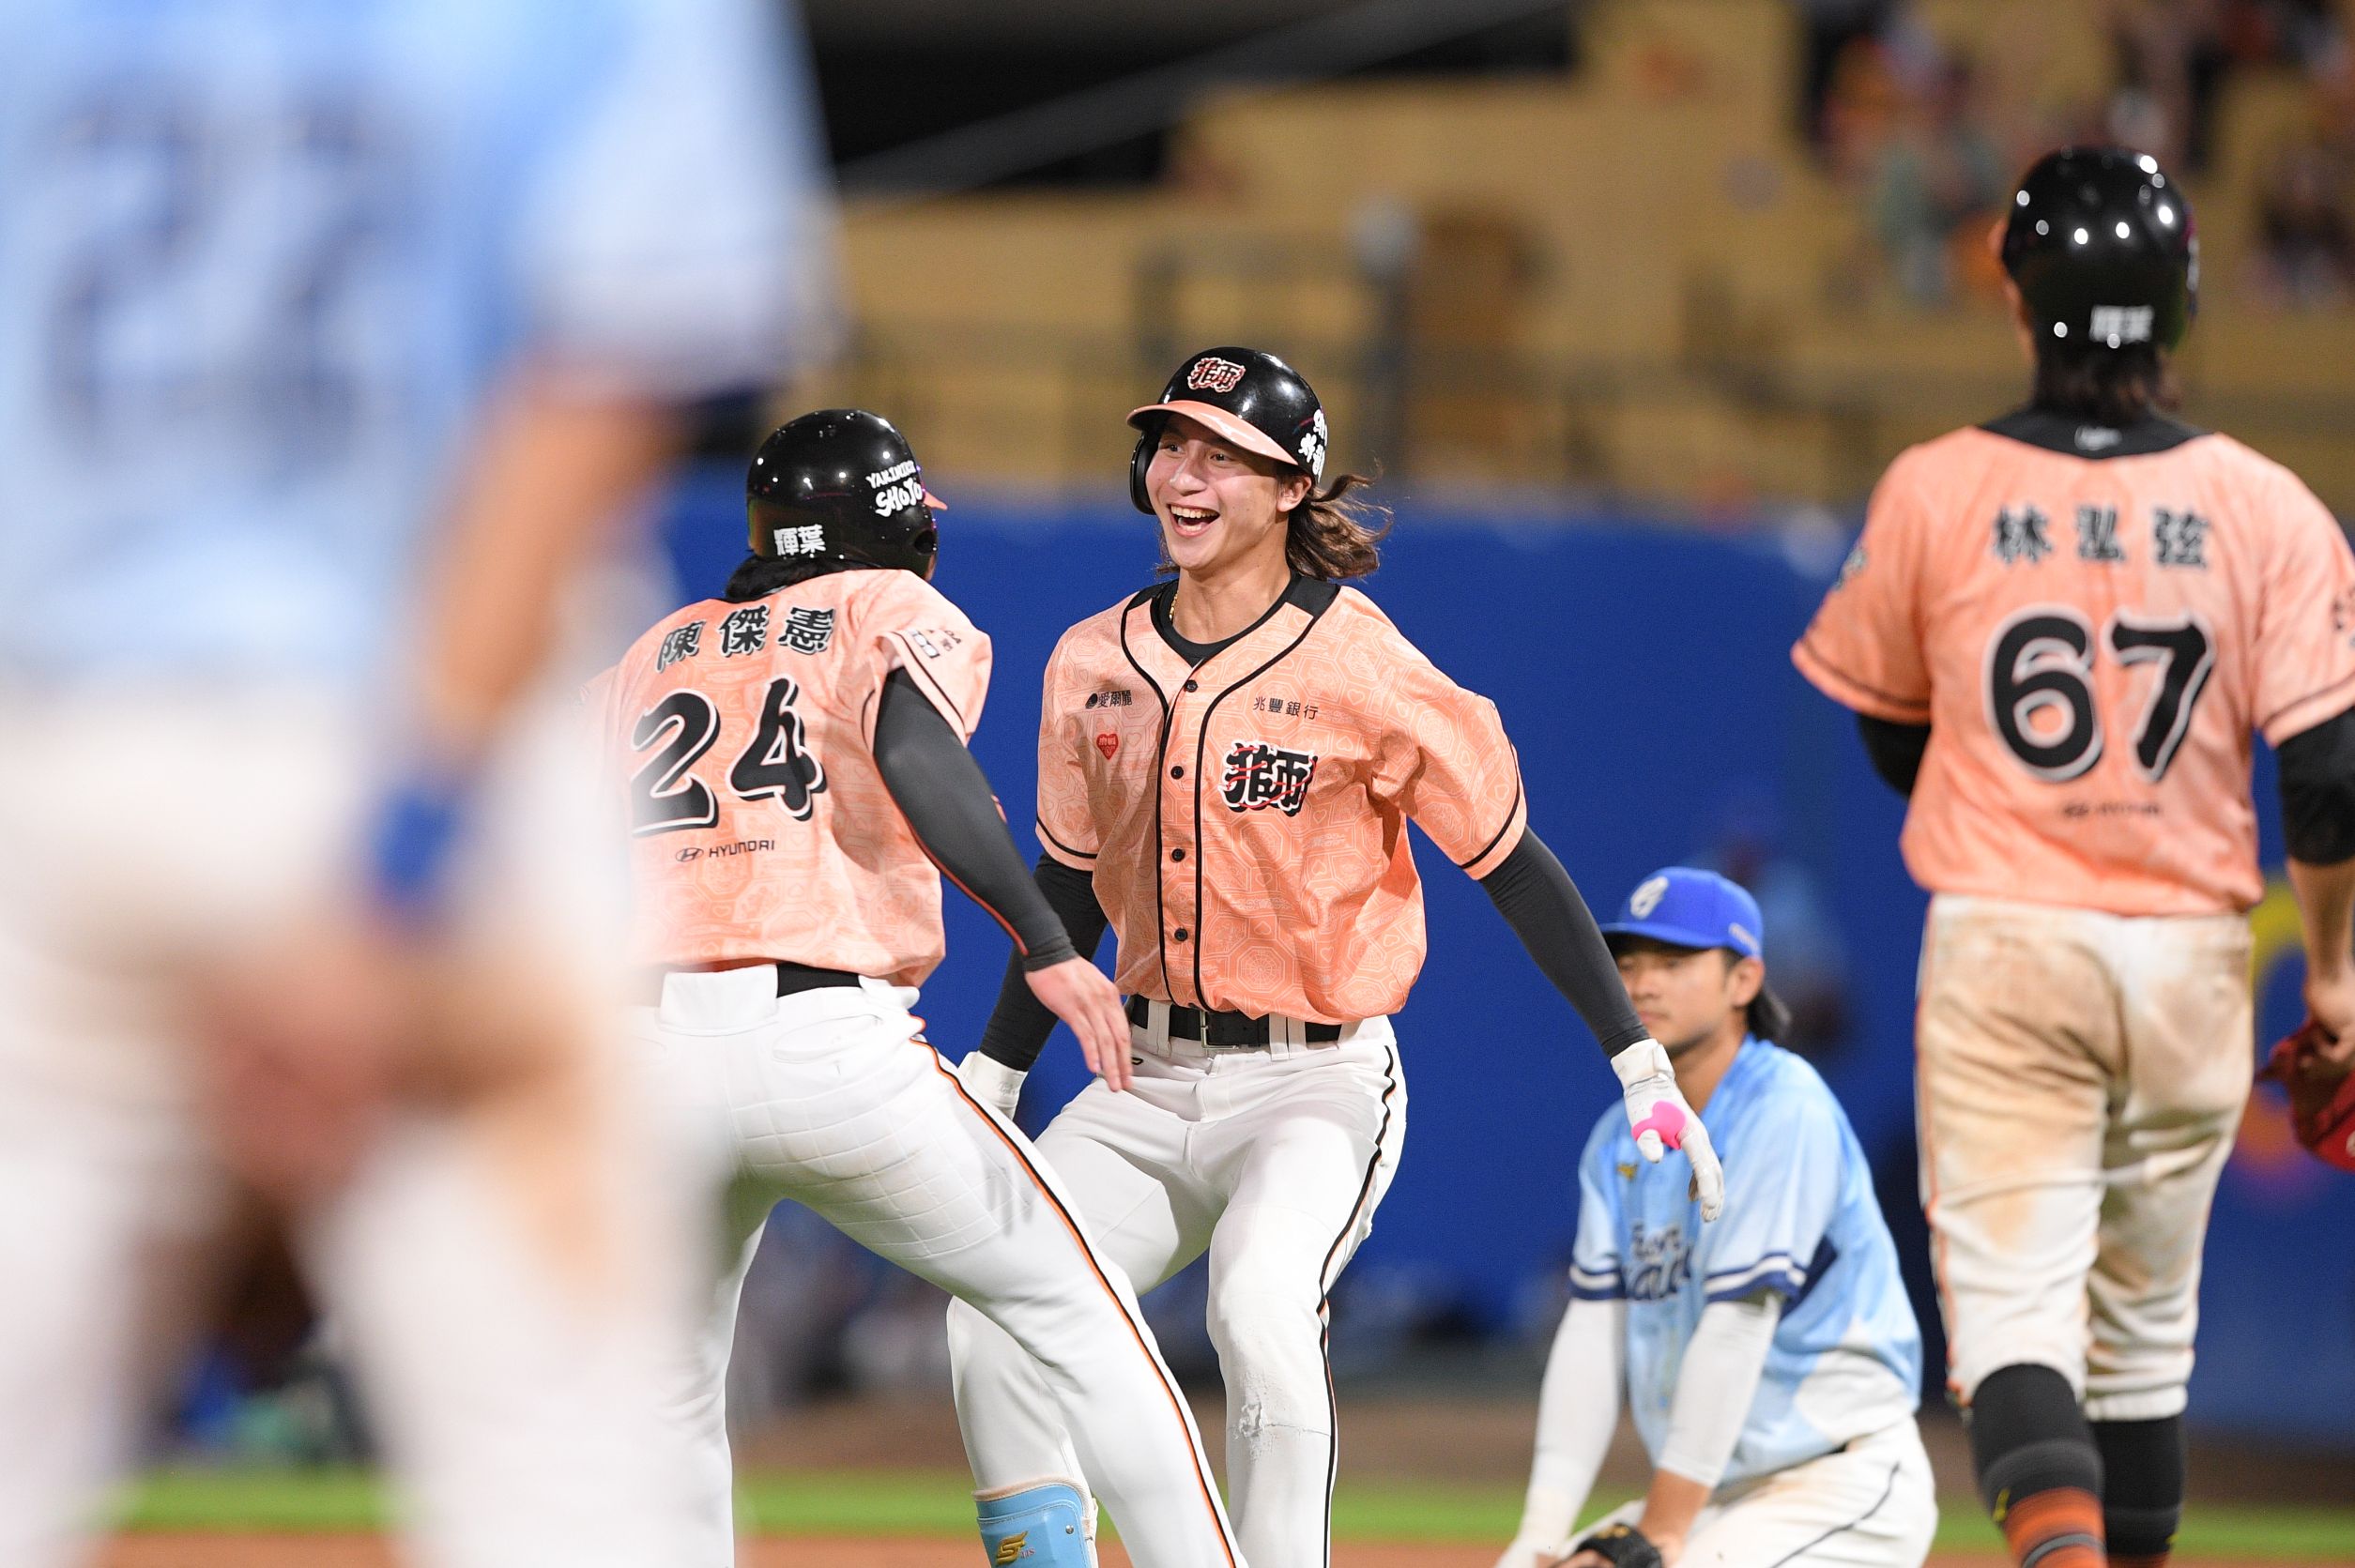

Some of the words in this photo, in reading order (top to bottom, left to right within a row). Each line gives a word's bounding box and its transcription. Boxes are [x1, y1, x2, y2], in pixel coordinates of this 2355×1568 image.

[657, 604, 836, 673] 陳傑憲
[1252, 696, 1319, 720] 兆豐銀行
[1981, 603, 2216, 784] 67
[632, 674, 828, 837] 24
[709, 840, 775, 858] HYUNDAI
